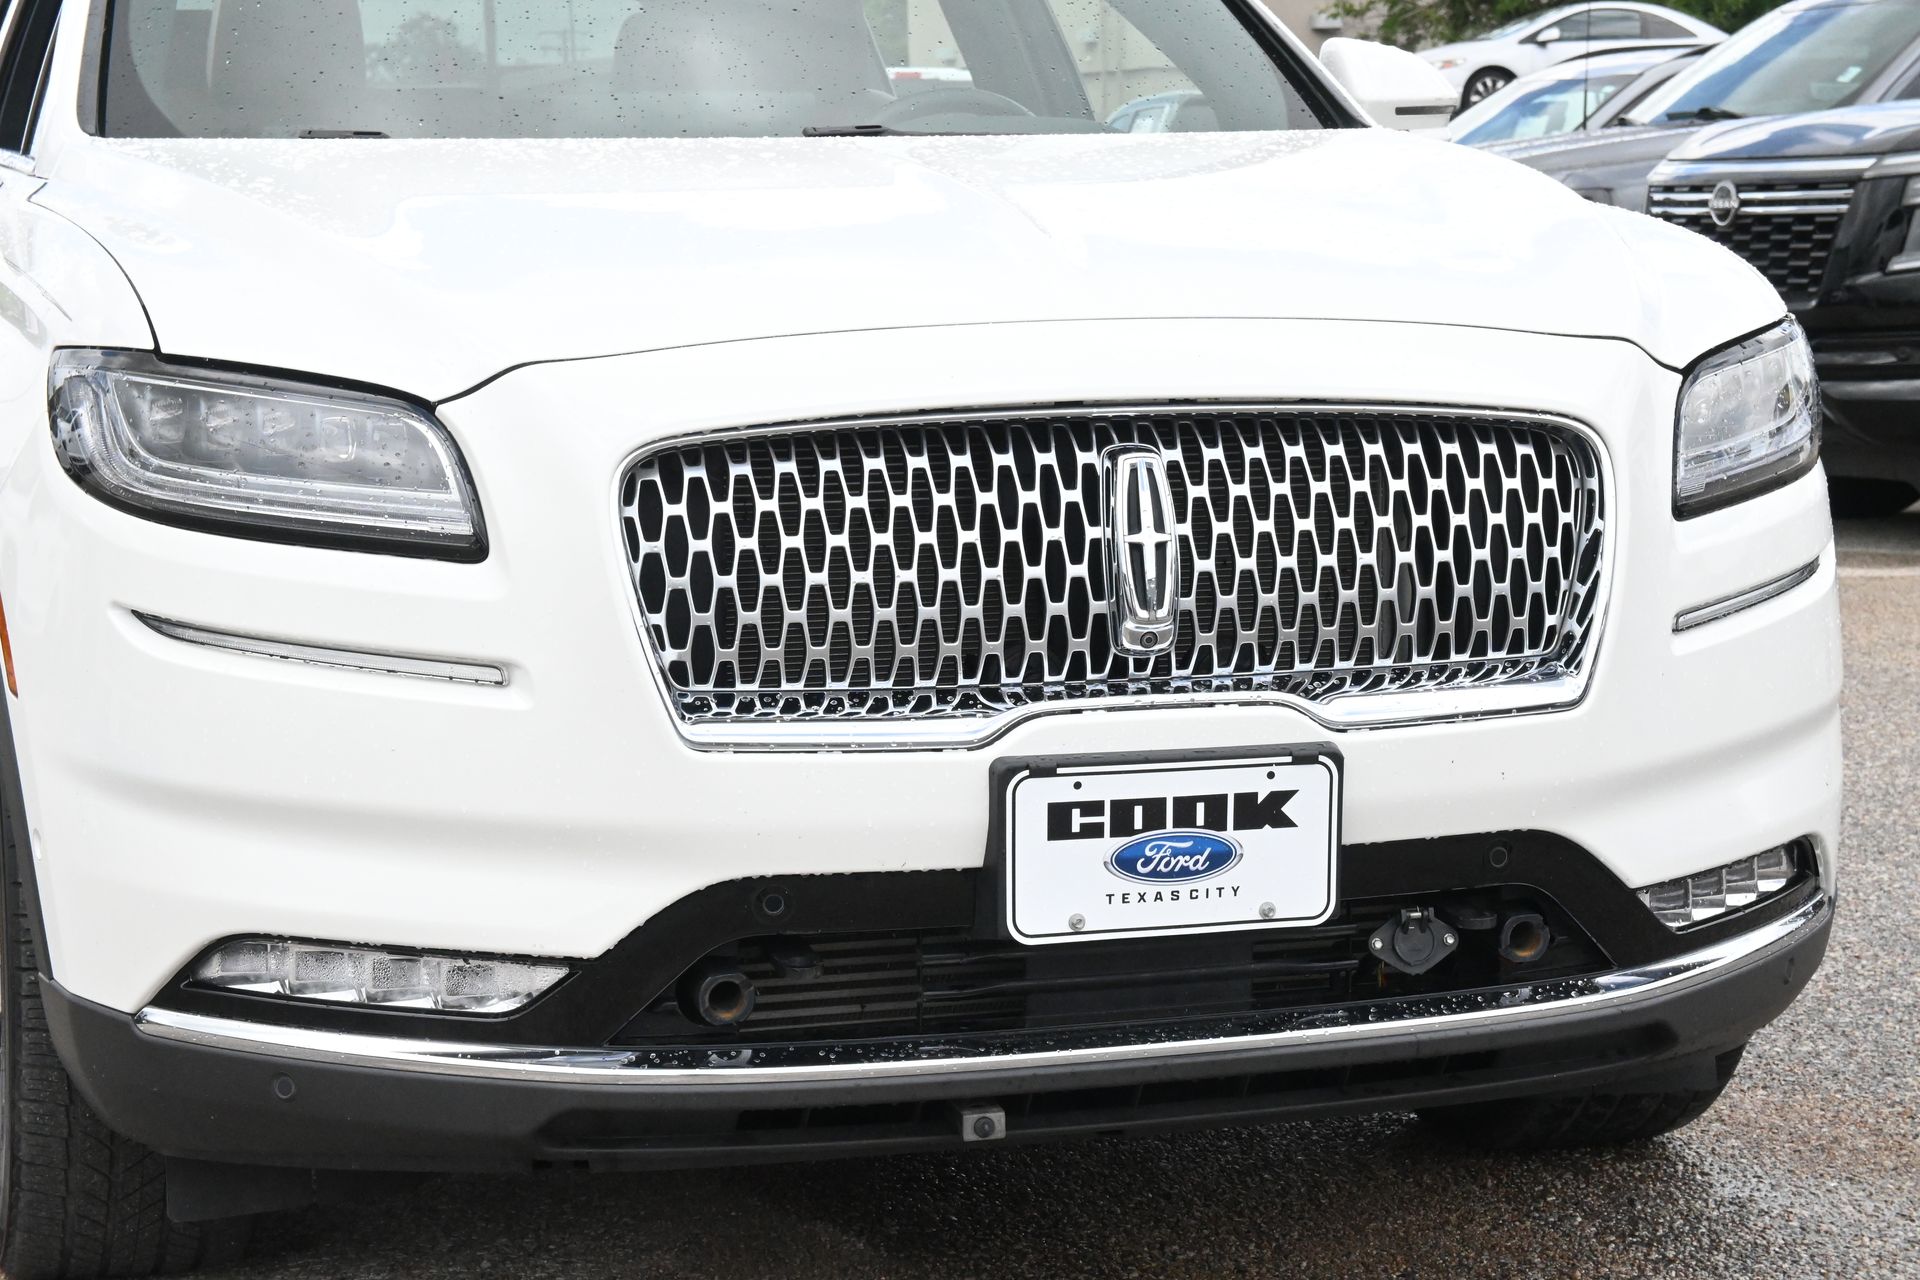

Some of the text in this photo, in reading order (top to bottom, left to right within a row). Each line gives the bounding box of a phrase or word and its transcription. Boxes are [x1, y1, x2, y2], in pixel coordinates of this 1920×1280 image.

[1046, 789, 1300, 841] COOK
[1136, 840, 1212, 873] Ford
[1105, 885, 1240, 905] TEXAS CITY
